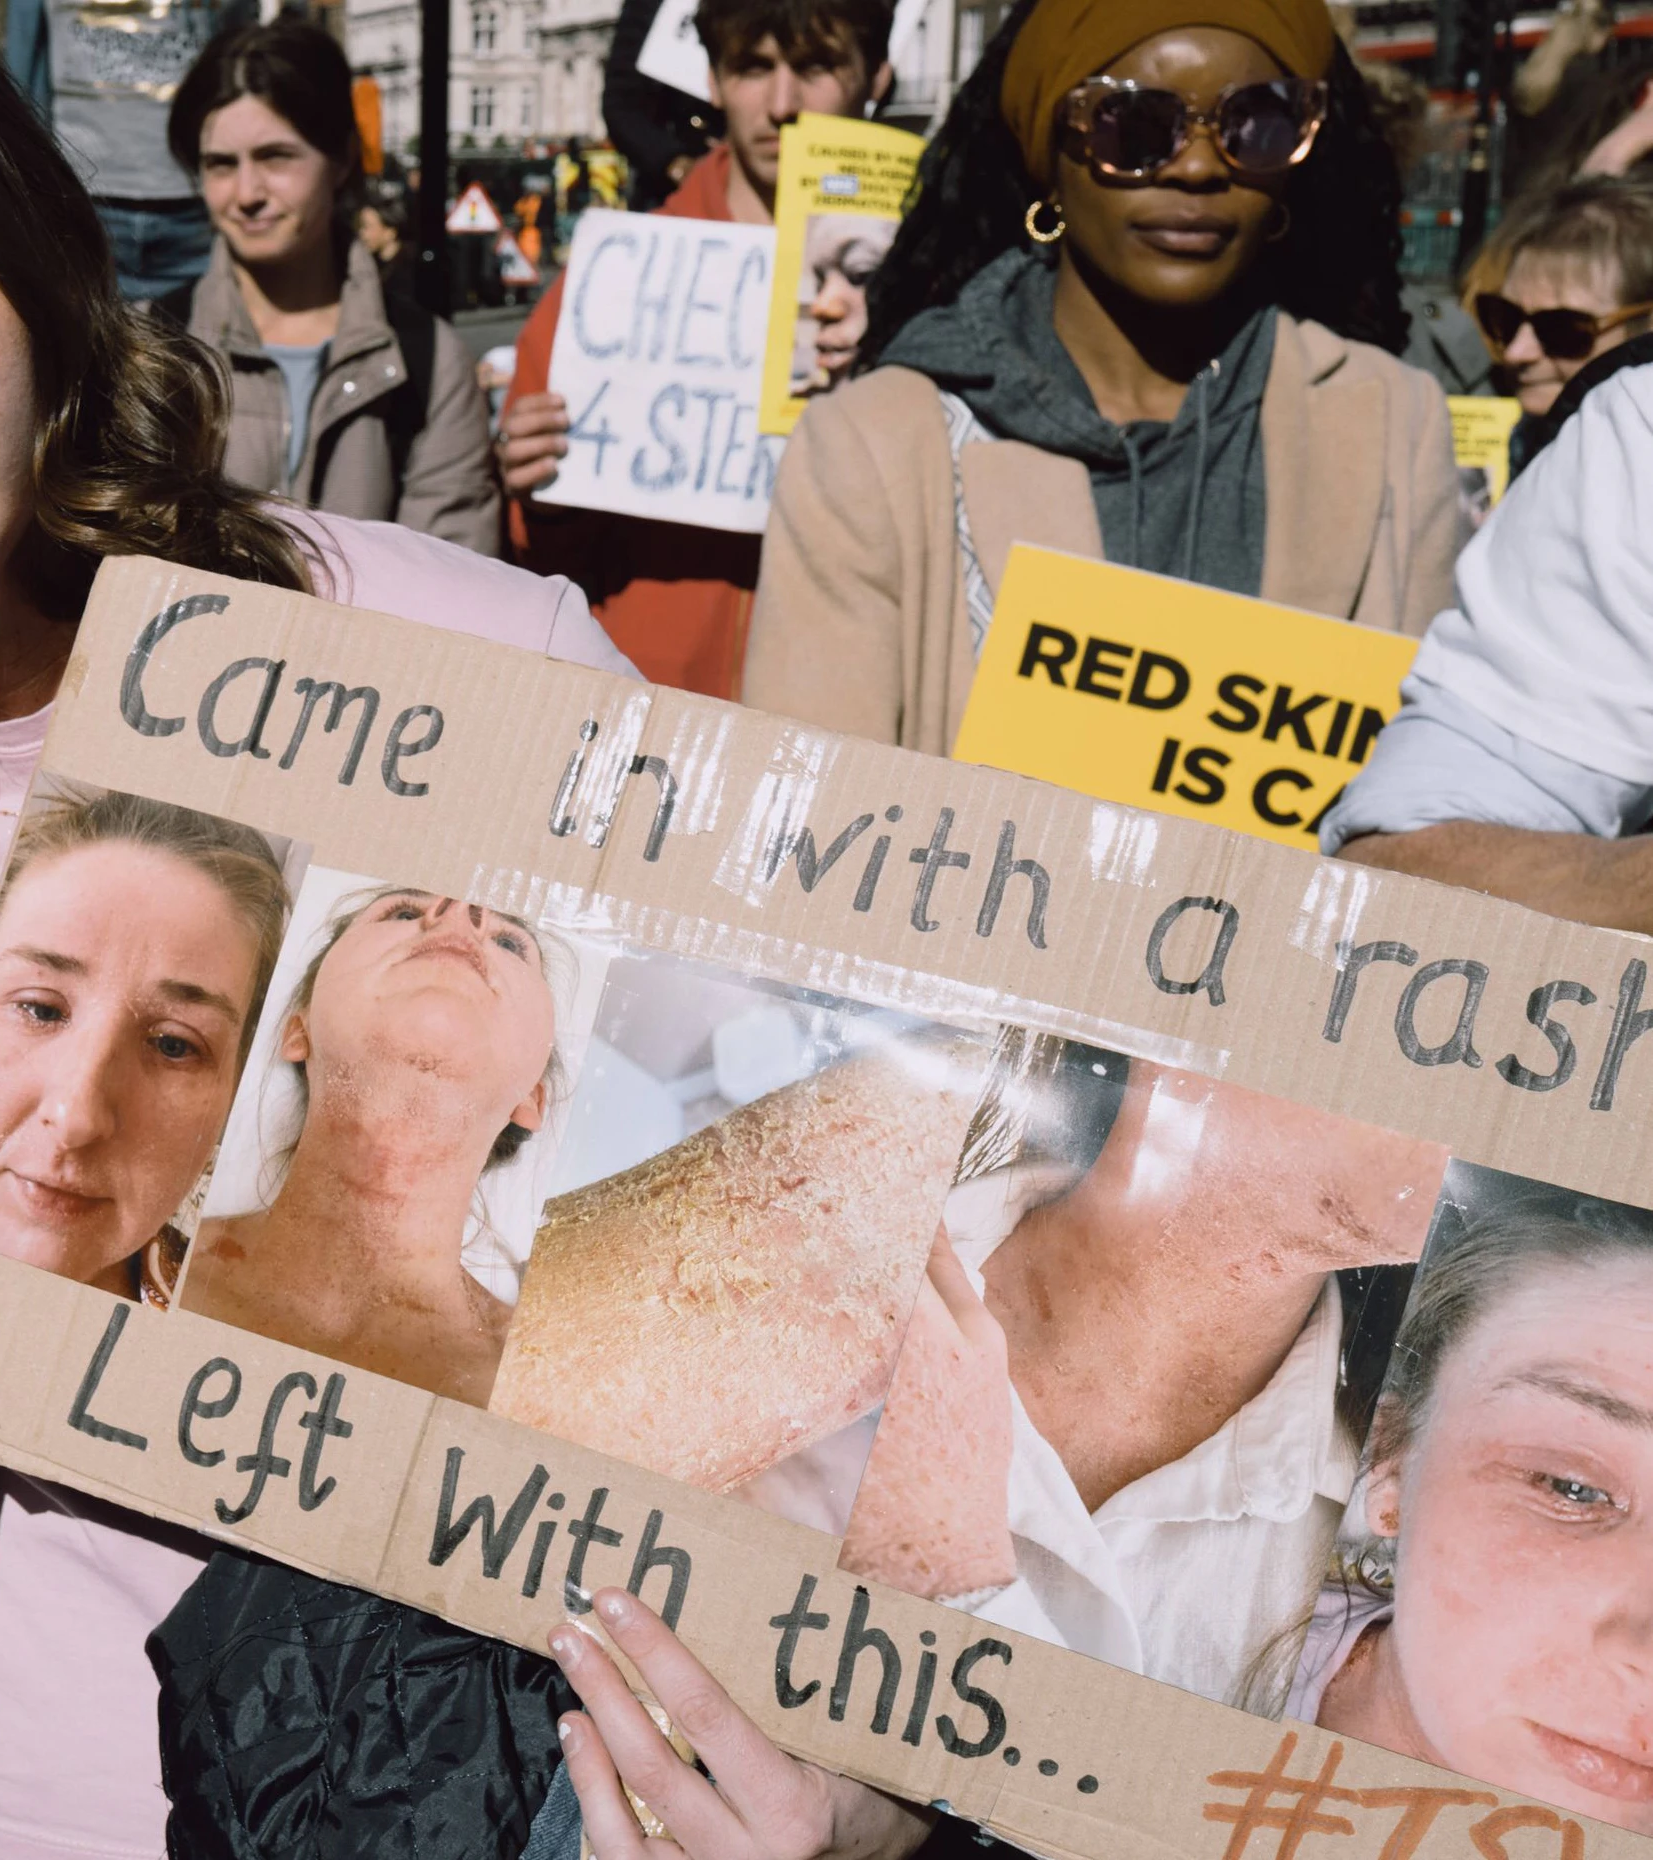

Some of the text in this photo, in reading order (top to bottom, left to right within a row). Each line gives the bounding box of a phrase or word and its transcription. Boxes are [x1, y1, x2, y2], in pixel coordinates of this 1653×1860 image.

[568, 380, 621, 478] 4
[1017, 621, 1191, 712] RED
[119, 594, 445, 798] Came
[550, 719, 678, 863] in
[761, 778, 1051, 950] with
[1146, 896, 1239, 1006] a
[1151, 738, 1232, 806] IS
[67, 1302, 353, 1525] Left
[428, 1446, 692, 1634] With
